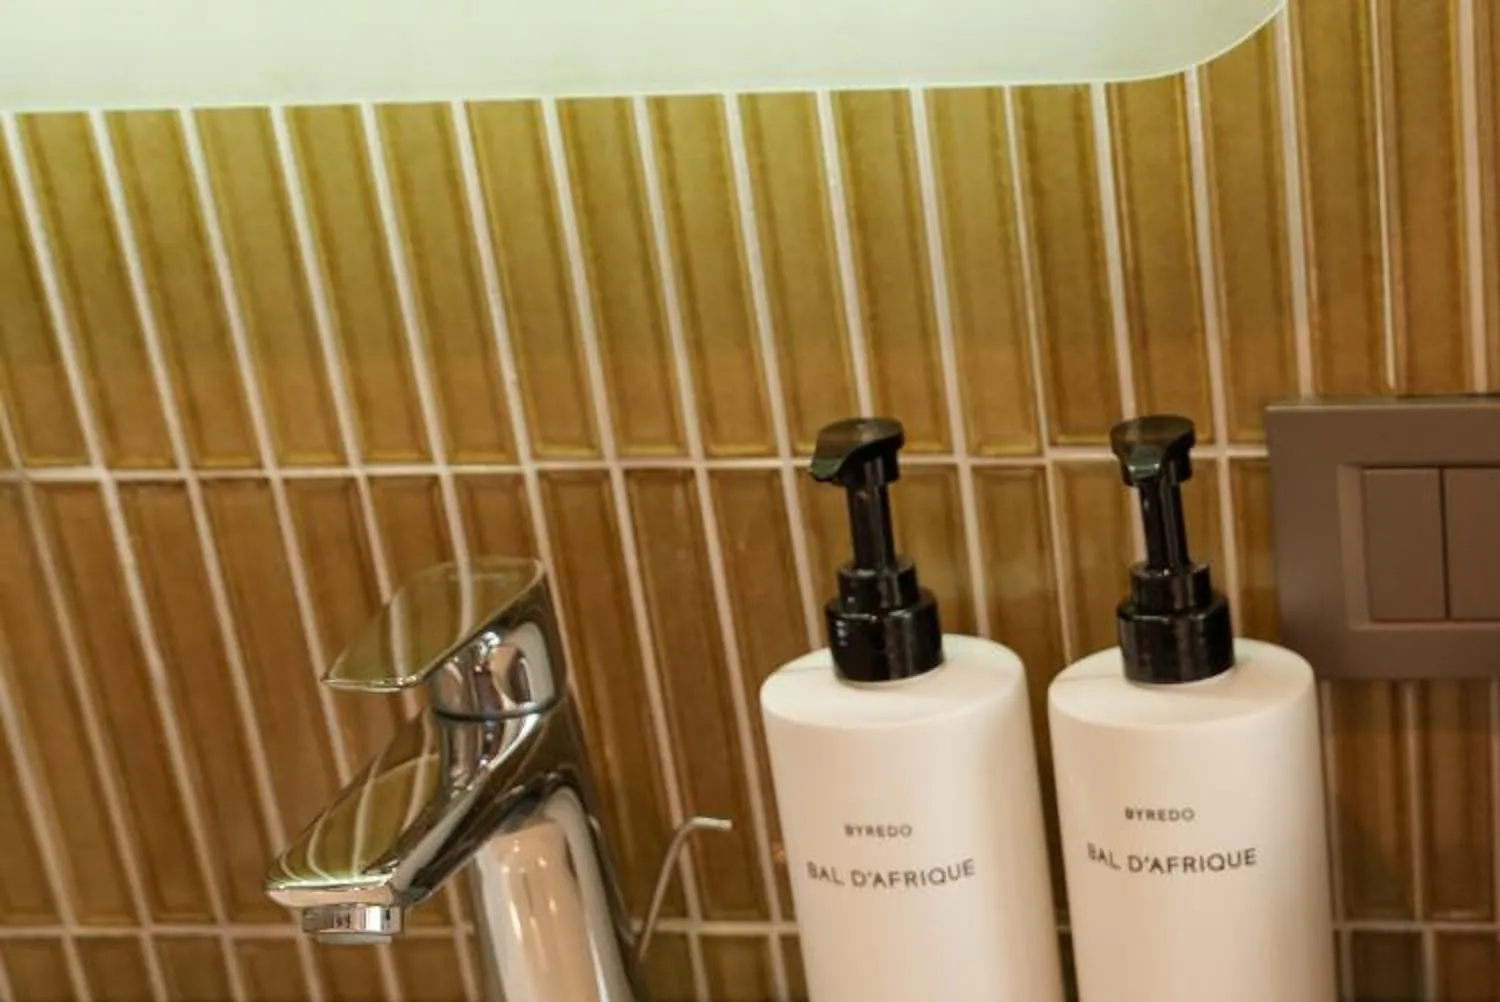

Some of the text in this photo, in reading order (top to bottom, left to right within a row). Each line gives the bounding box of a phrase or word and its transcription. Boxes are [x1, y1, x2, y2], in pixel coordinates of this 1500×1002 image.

[1125, 807, 1195, 822] BYREDO
[844, 824, 912, 838] BYREDO
[1087, 841, 1257, 873] BAL D'AFRIQUE
[807, 858, 976, 888] BAL D'AFRIQUE
